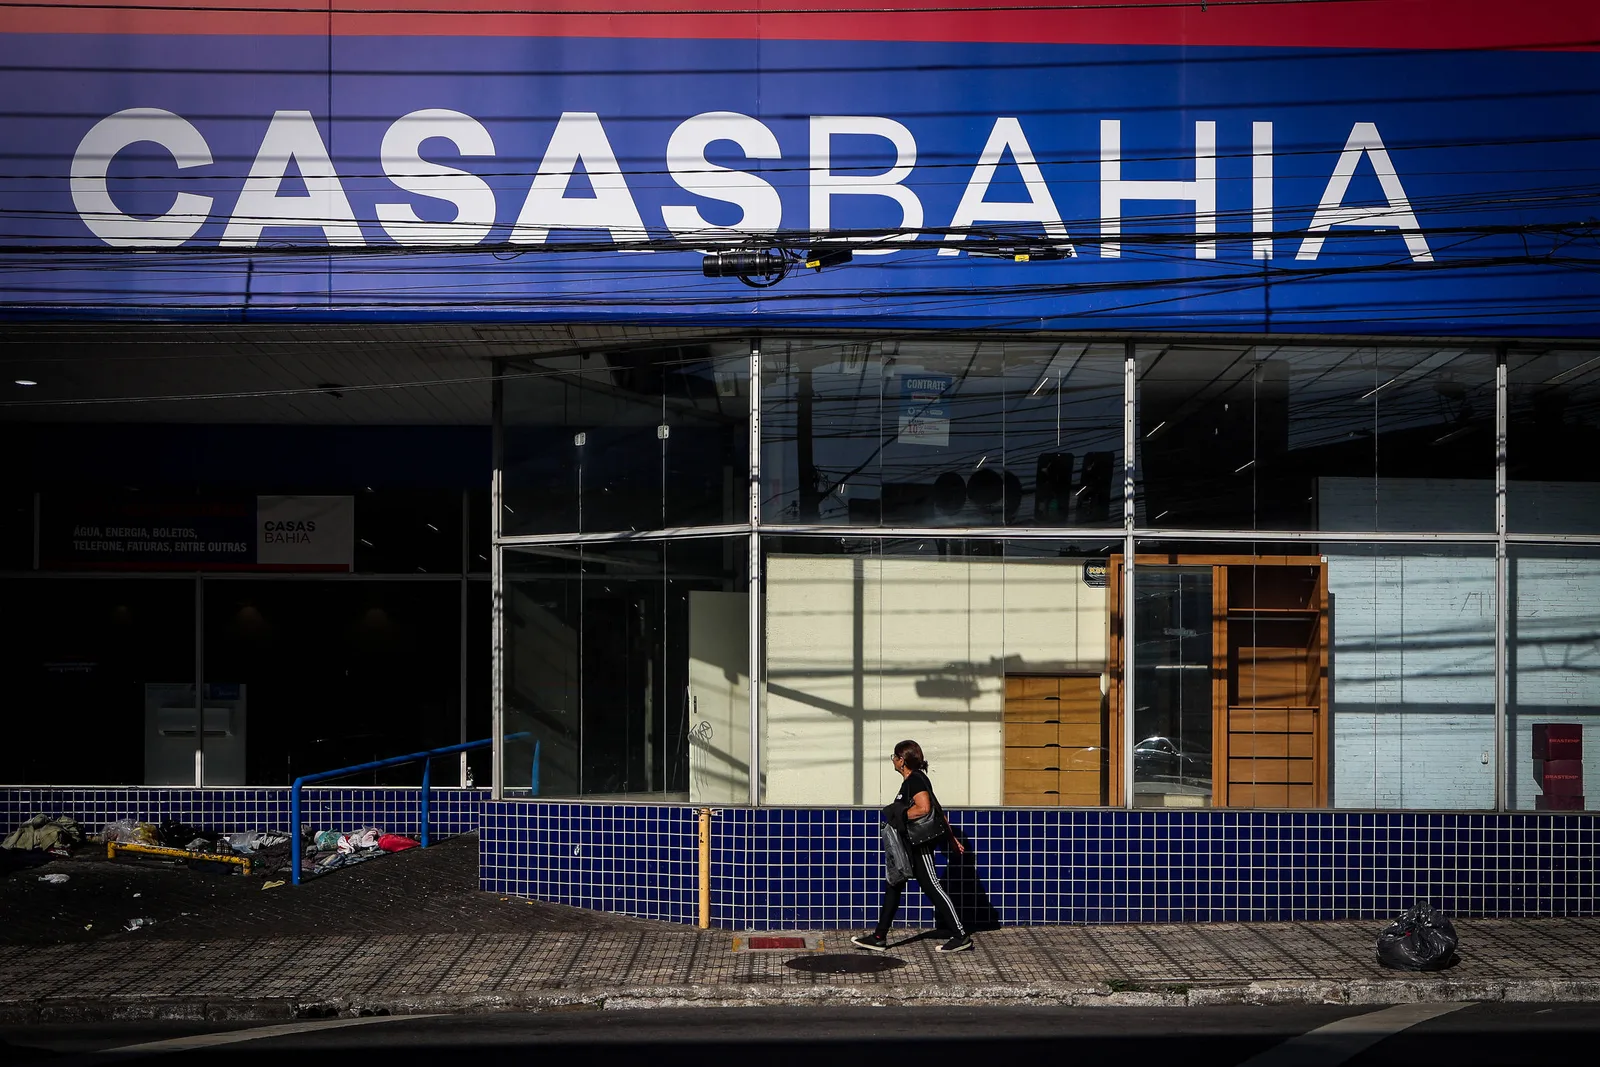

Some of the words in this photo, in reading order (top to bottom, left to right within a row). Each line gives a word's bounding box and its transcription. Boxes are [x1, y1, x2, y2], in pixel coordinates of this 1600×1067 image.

[906, 379, 946, 391] CONTRATE
[264, 520, 316, 532] CASAS
[73, 525, 103, 538] ÁGUA,
[105, 527, 150, 540] ENERGIA,
[152, 528, 198, 540] BOLETOS,
[264, 532, 311, 544] BAHIA
[73, 541, 125, 553] TELEFONE,
[127, 541, 173, 553] FATURAS,
[174, 542, 206, 552] ENTRE
[207, 542, 248, 553] OUTRAS
